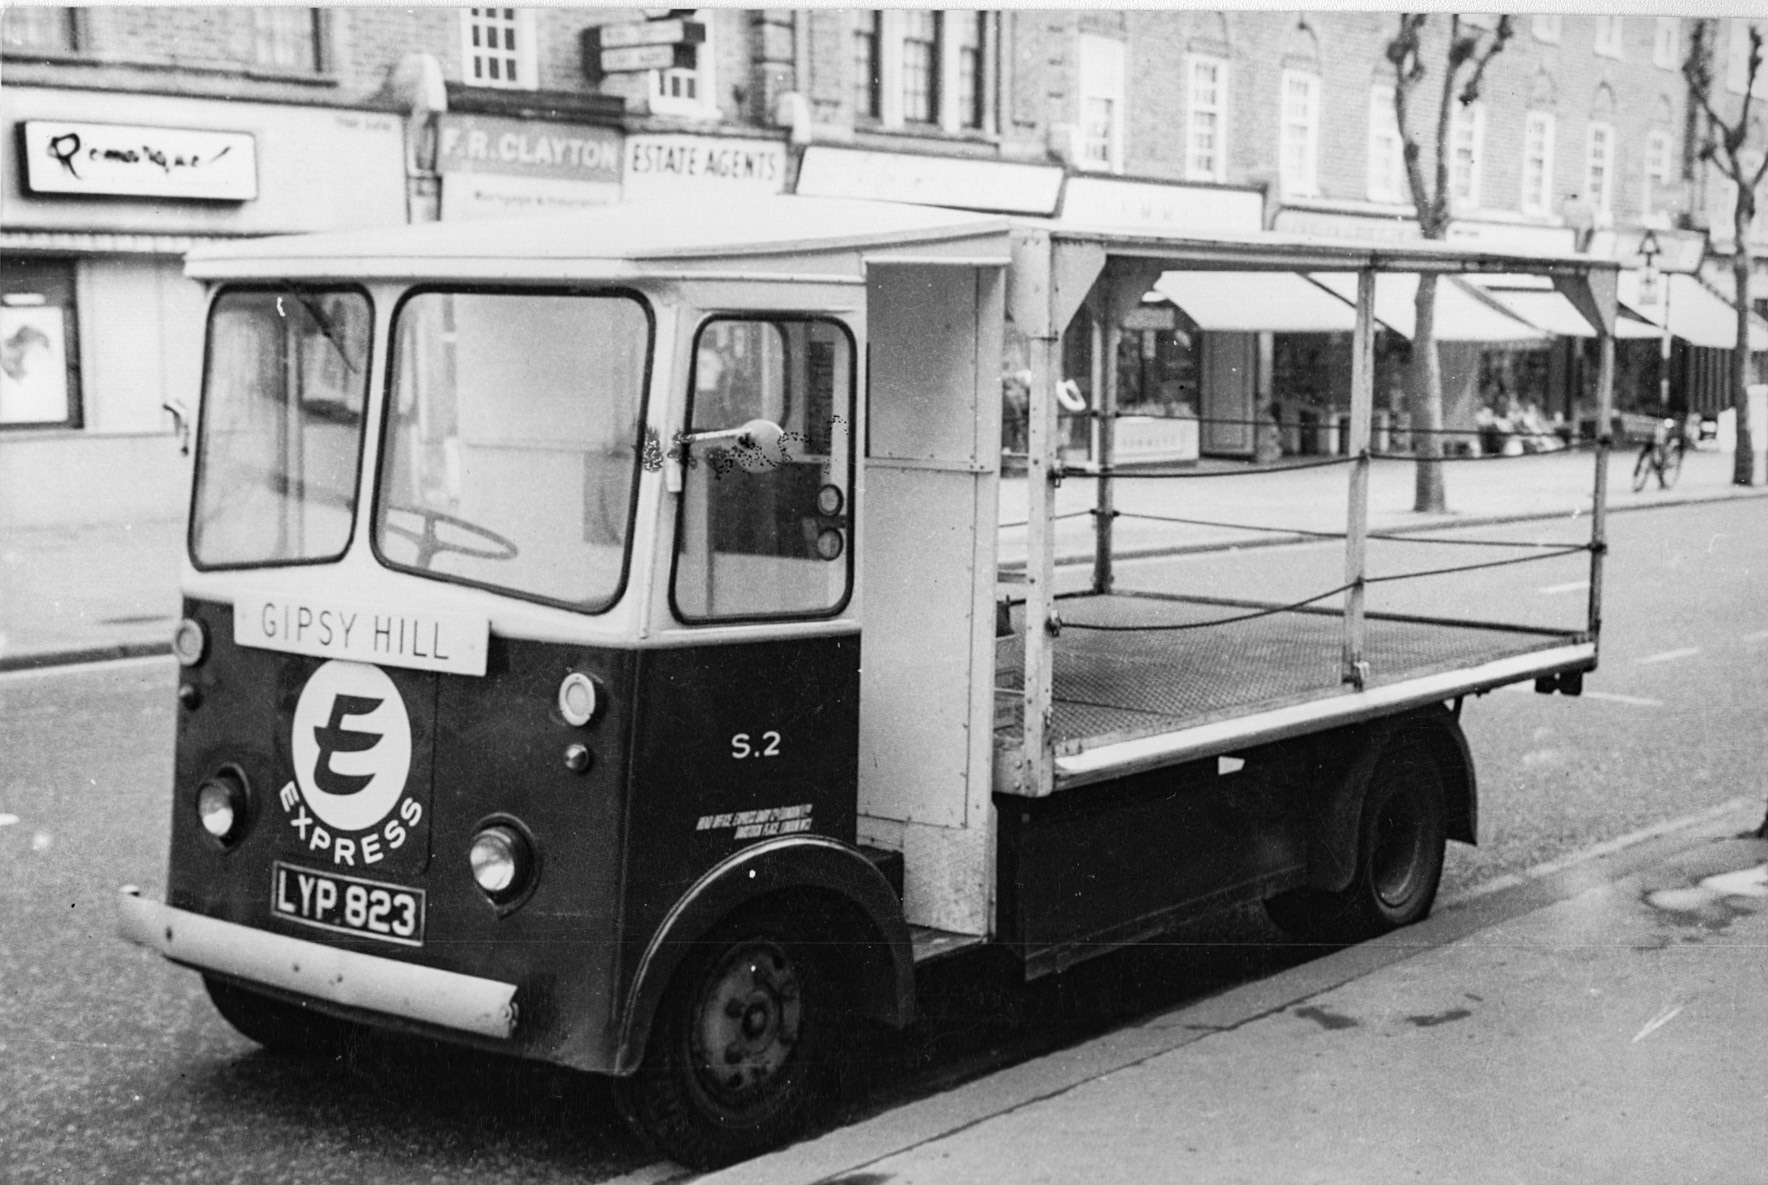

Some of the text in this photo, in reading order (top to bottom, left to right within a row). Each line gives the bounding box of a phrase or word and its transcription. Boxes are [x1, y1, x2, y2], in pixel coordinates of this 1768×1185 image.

[633, 144, 776, 180] ESTATE AGENTS
[262, 602, 449, 660] GIPSY HILL
[731, 731, 781, 759] S.2
[279, 780, 423, 867] EXPRESS
[278, 869, 417, 937] LYP 823
